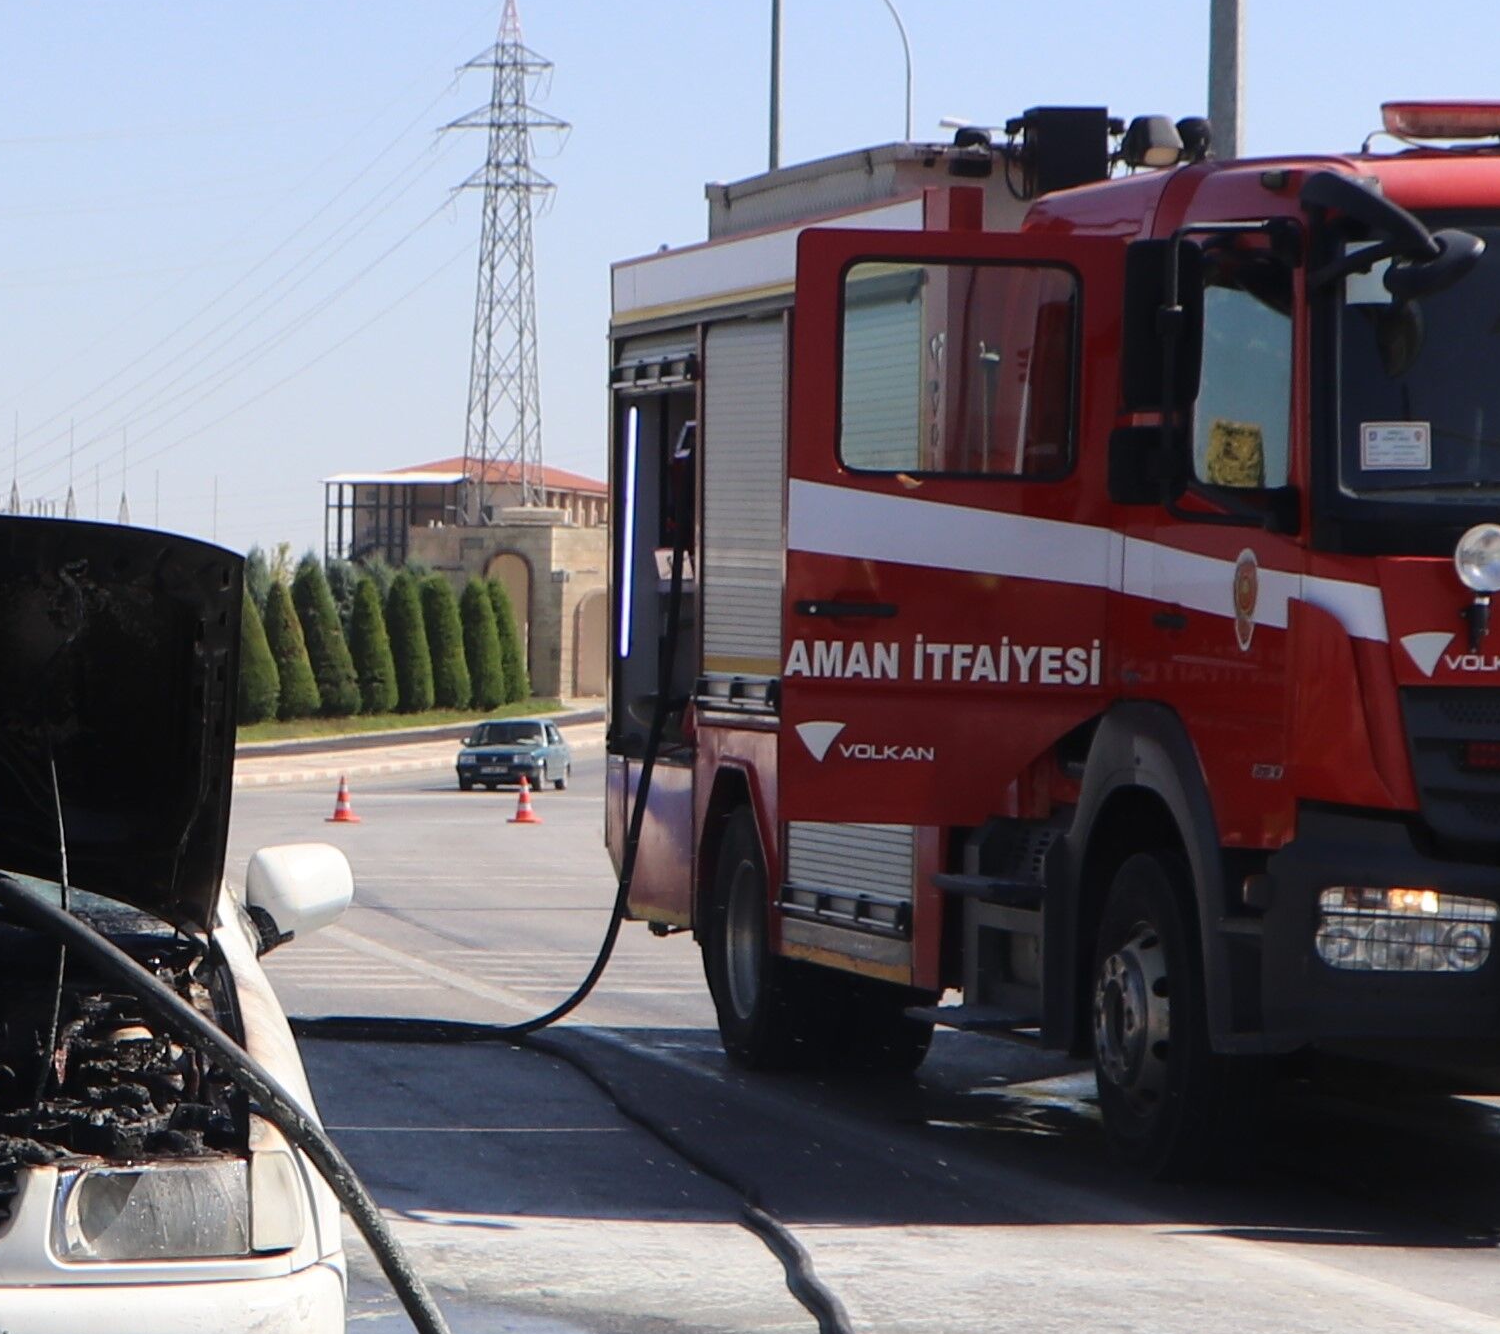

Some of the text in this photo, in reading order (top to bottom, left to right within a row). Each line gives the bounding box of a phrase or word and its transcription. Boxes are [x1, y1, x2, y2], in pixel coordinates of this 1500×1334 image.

[784, 640, 899, 679] AMAN
[913, 633, 1100, 686] İTFAİYESİ
[839, 742, 935, 761] VOLKAN
